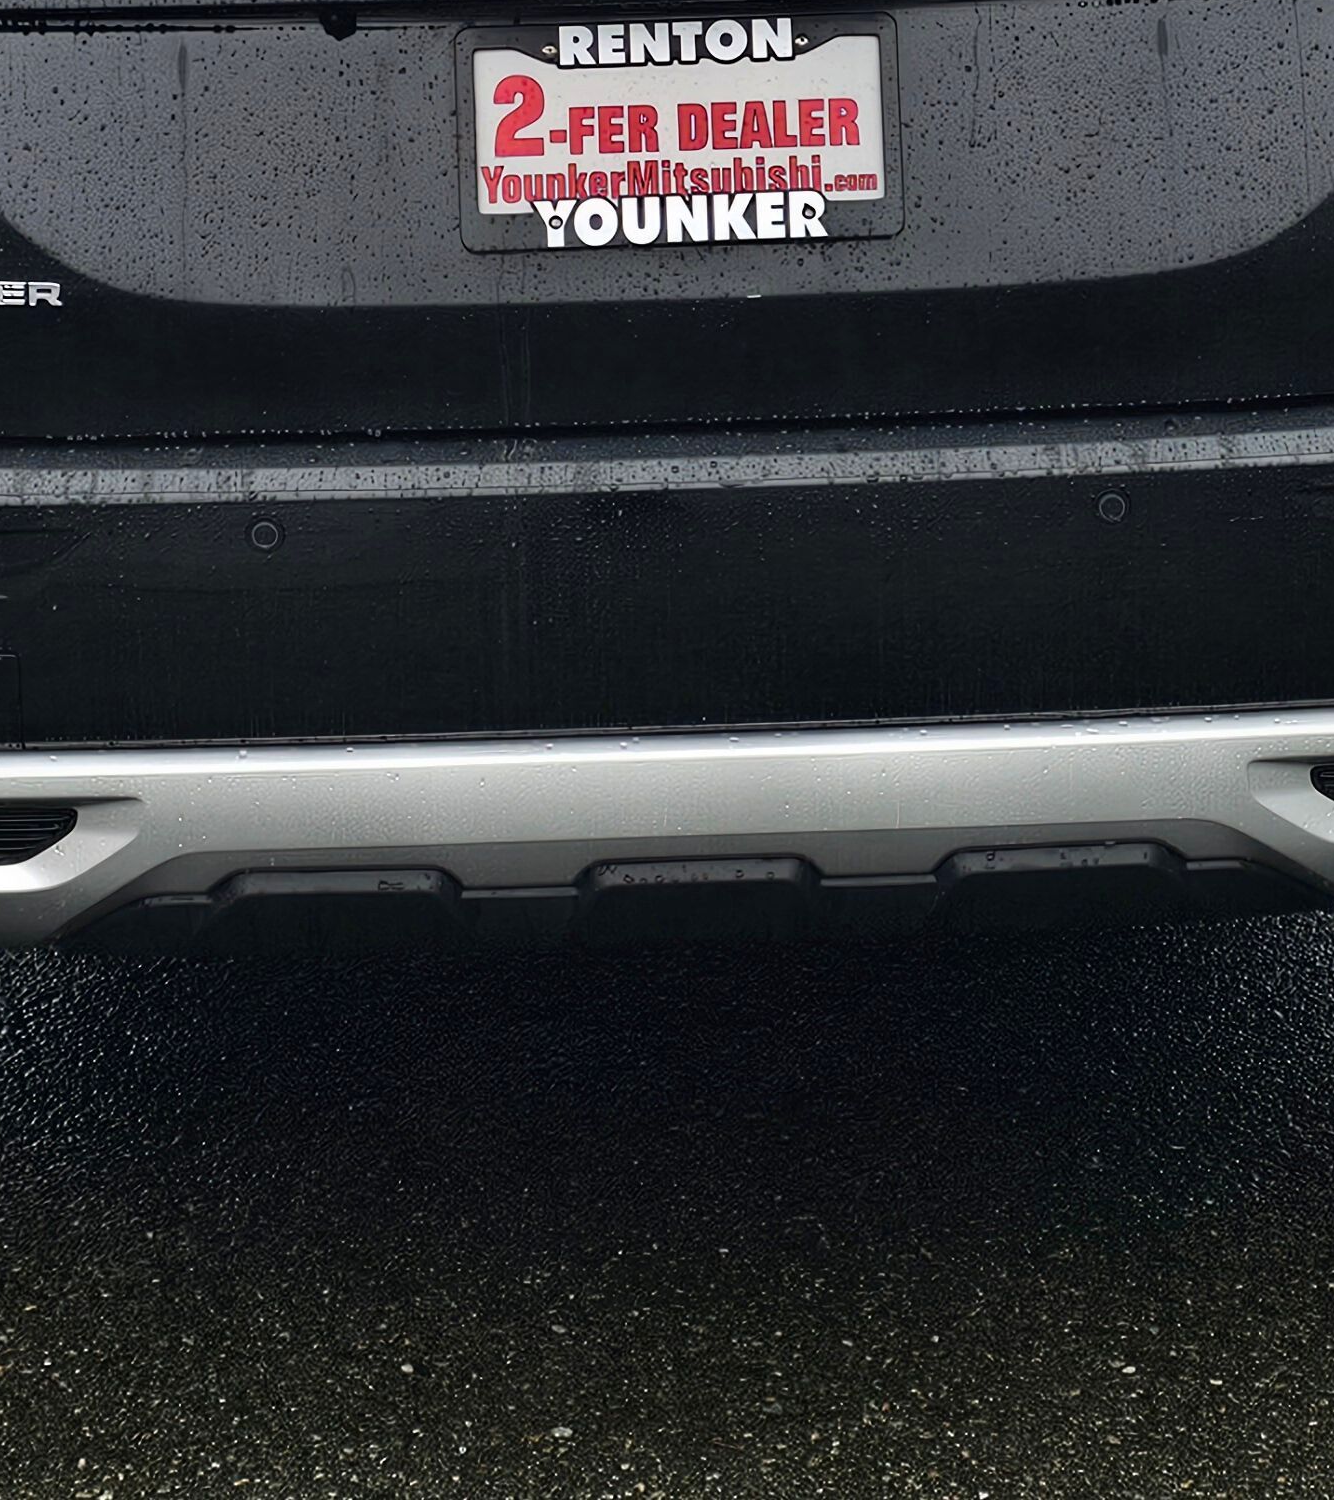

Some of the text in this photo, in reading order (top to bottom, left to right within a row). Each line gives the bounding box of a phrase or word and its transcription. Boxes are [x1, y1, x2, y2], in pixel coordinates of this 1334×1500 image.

[557, 18, 793, 66] RENTON
[493, 74, 860, 158] 2-FER DEALER
[531, 190, 829, 248] YOUNKER
